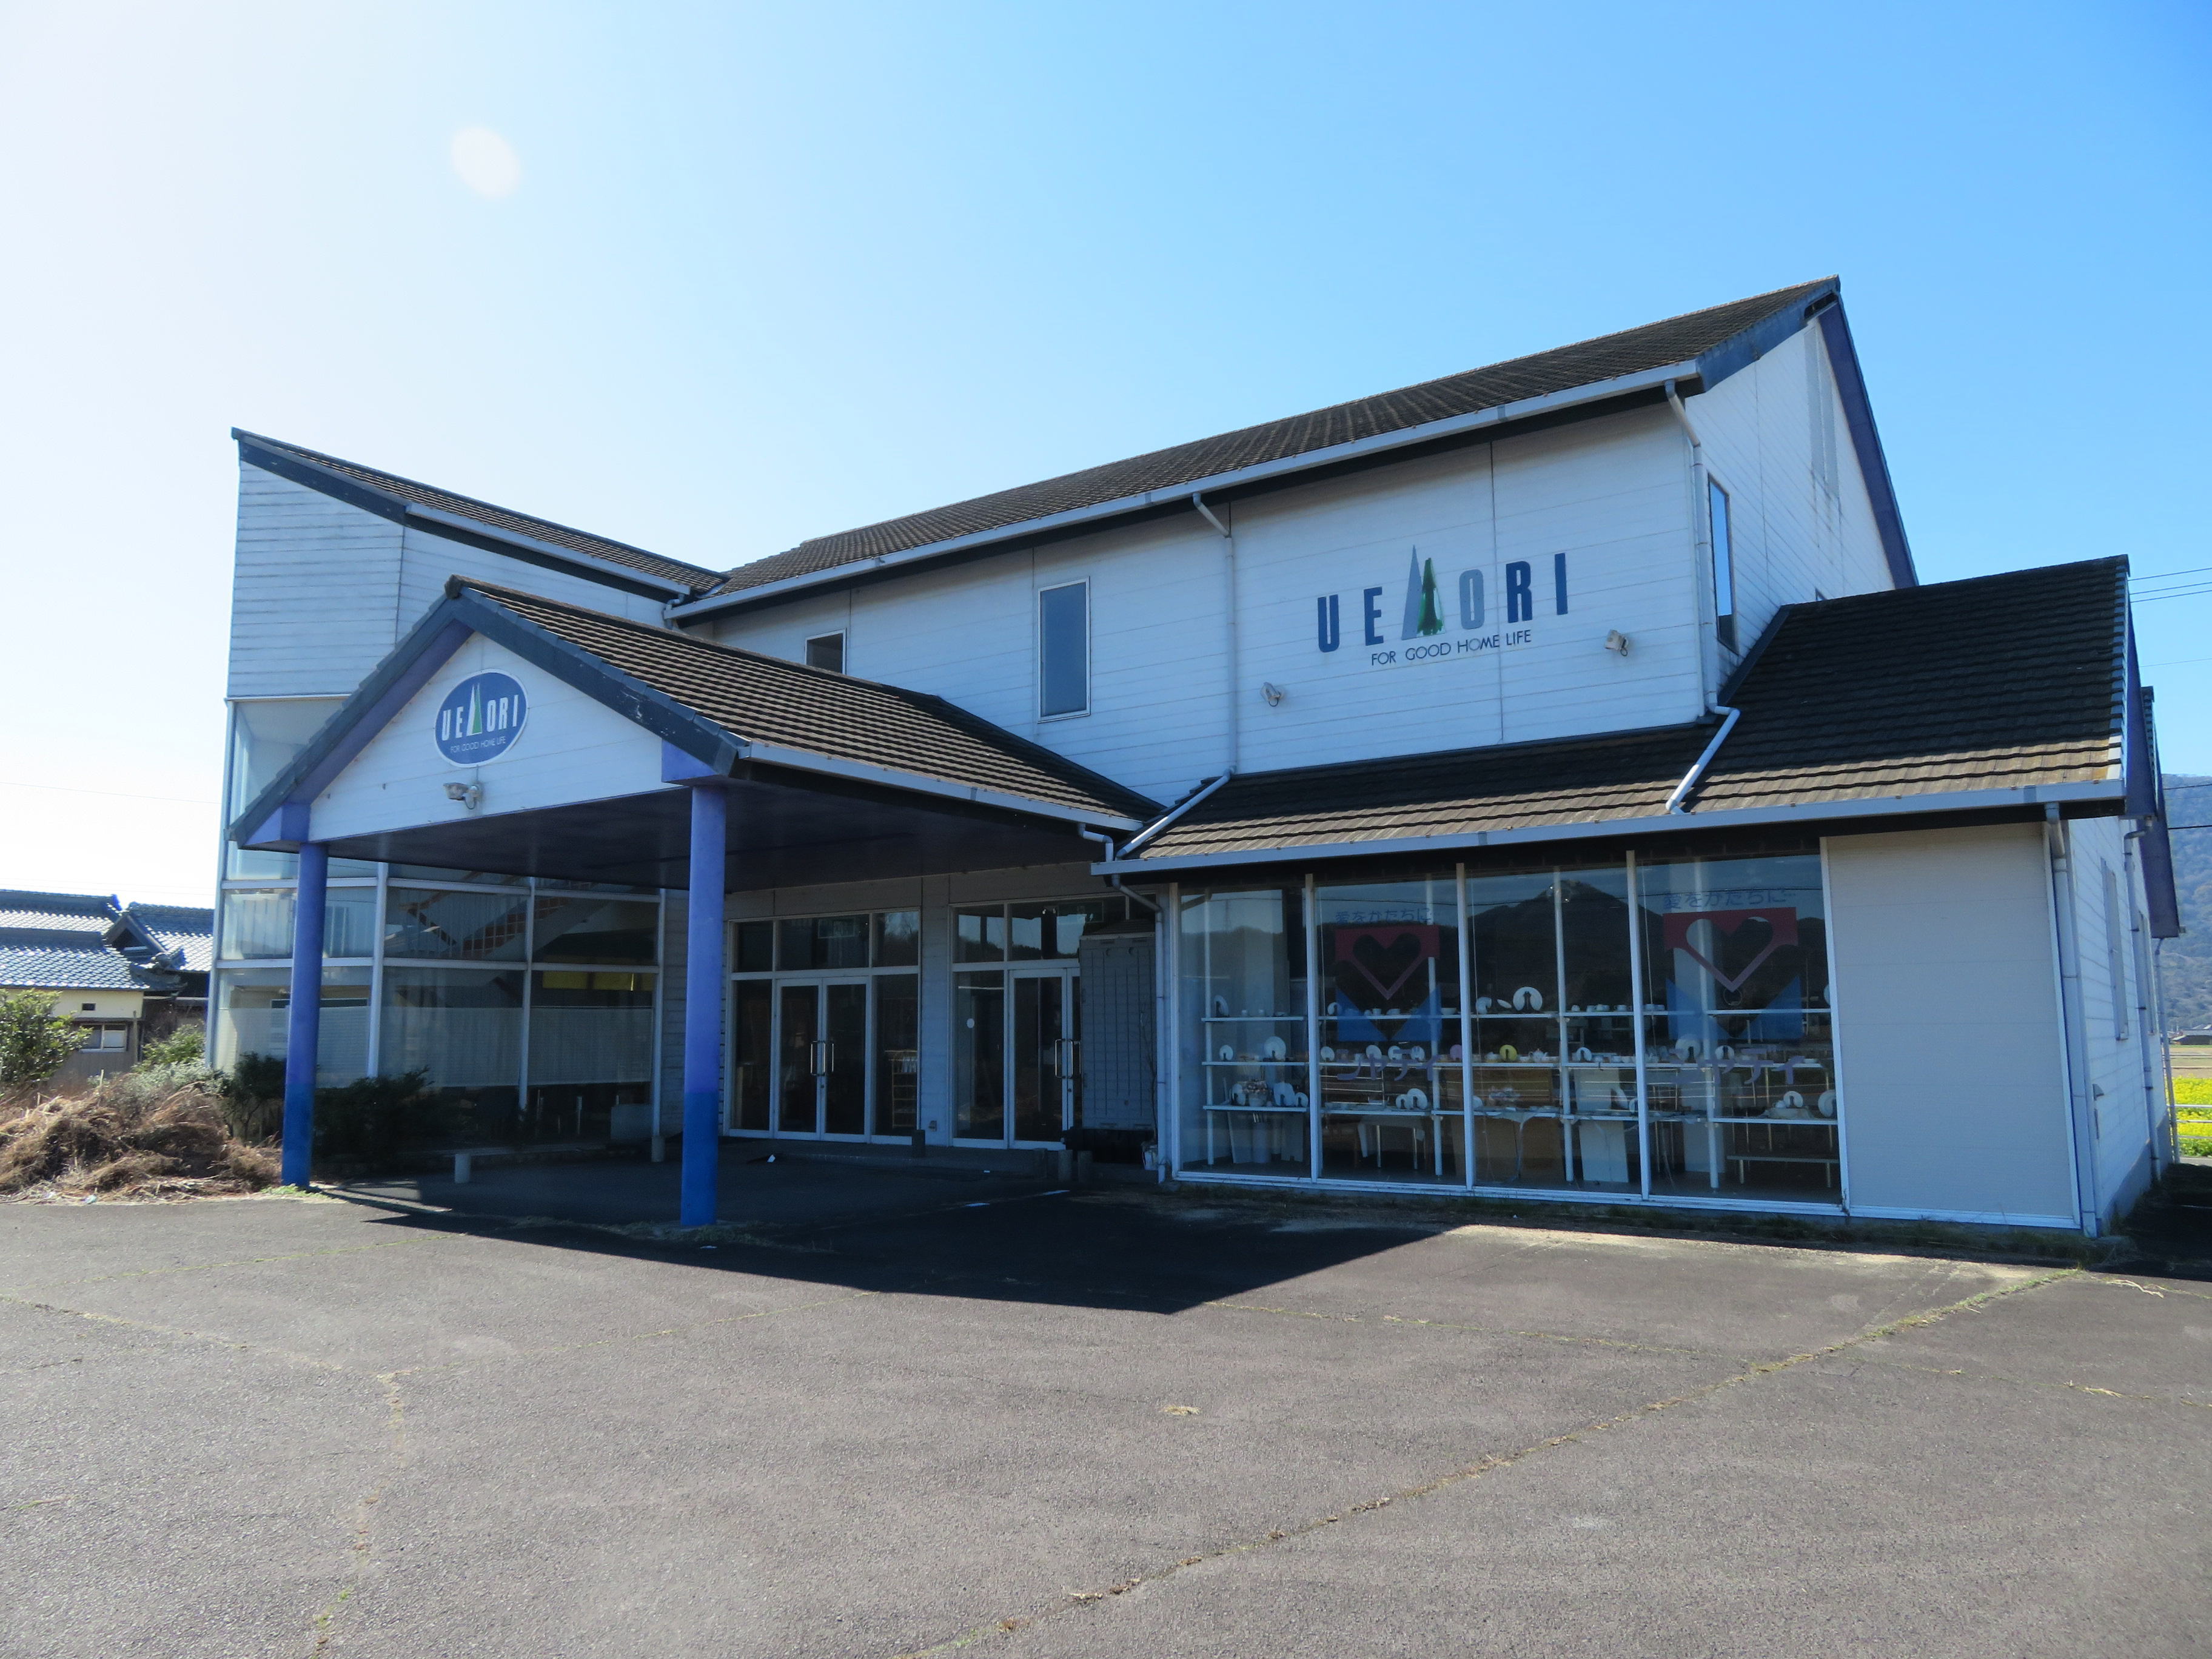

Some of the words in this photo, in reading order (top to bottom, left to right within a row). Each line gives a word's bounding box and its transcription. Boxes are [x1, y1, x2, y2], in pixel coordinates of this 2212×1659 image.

[1372, 651, 1396, 666] FOR
[1406, 643, 1451, 660] GOOD
[1458, 635, 1500, 653] HOME
[1506, 629, 1531, 646] LIFE
[461, 742, 480, 751] GOOD
[481, 738, 495, 748] HOME
